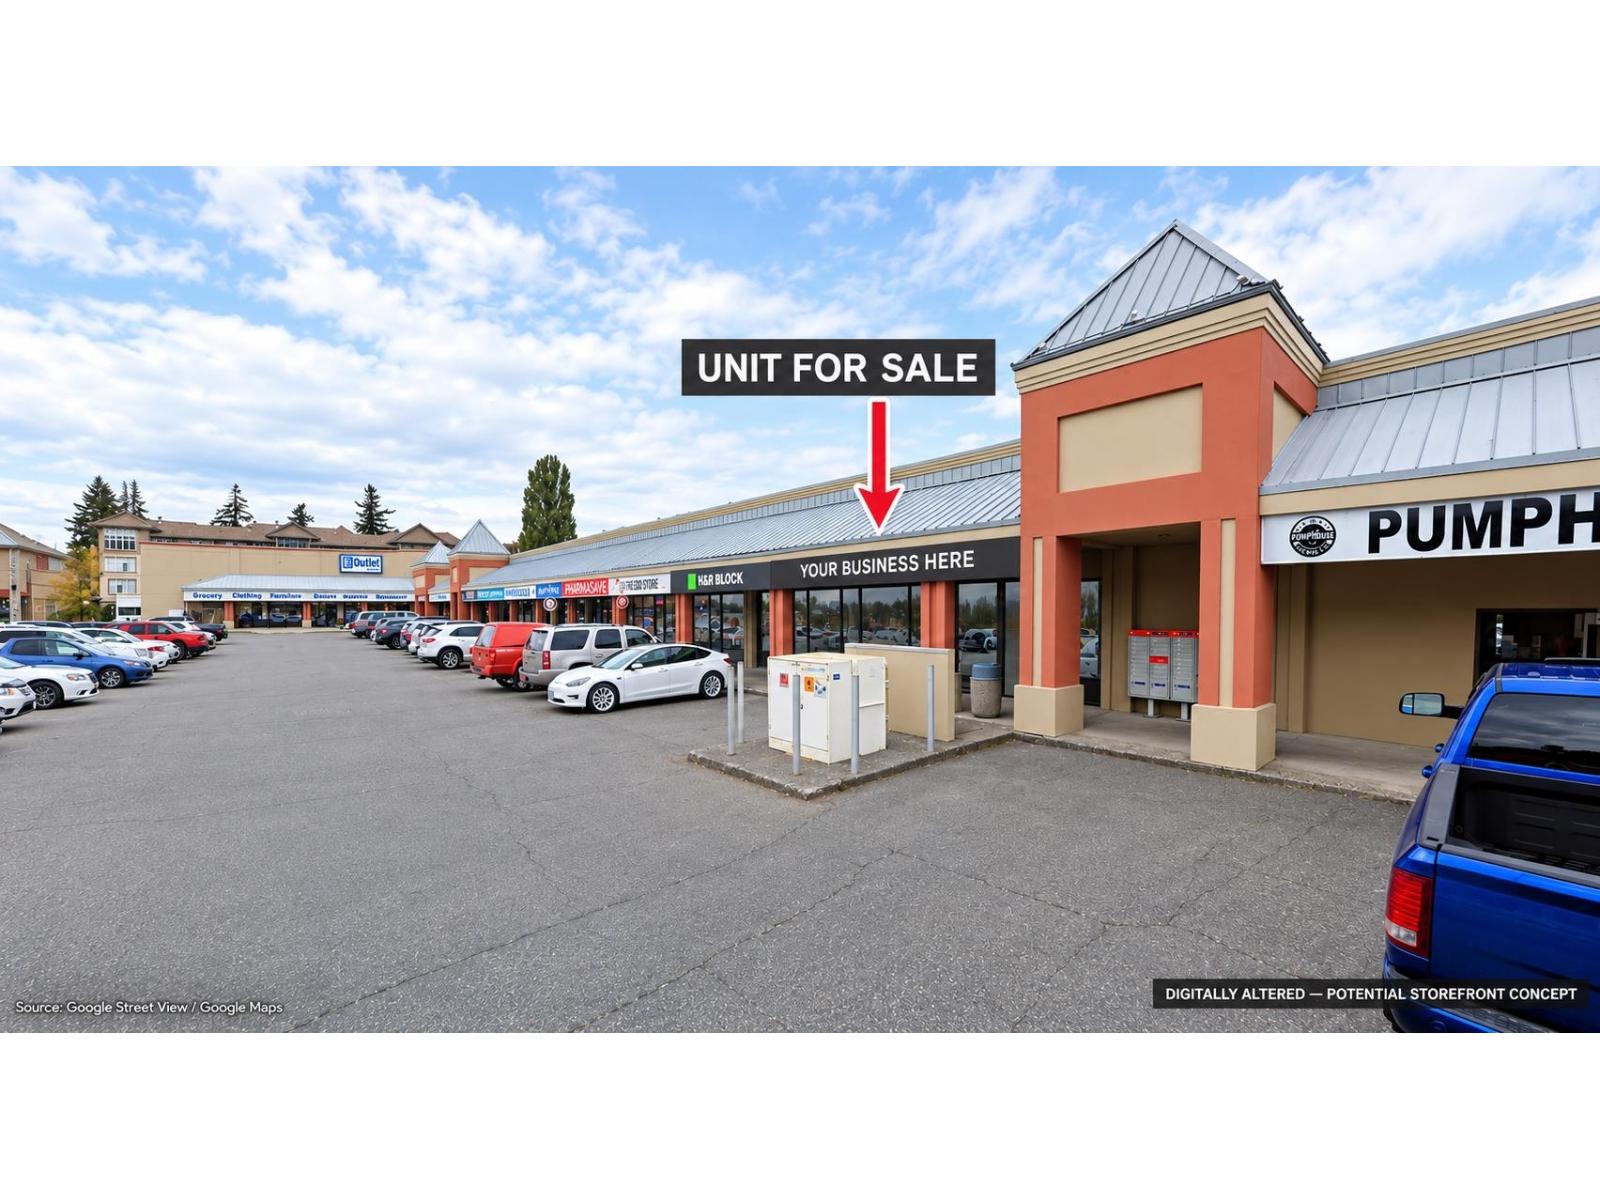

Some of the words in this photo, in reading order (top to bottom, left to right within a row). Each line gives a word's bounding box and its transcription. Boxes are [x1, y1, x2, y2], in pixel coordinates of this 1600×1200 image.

[1368, 491, 1600, 554] PUMPH
[353, 557, 380, 568] Outlet
[800, 561, 838, 579] YOUR
[842, 554, 919, 575] BUSINESS
[924, 549, 975, 570] HERE
[698, 574, 714, 587] H&R
[714, 571, 744, 586] BLOCK
[192, 592, 223, 600] Grocery
[232, 592, 262, 600] Clothing
[564, 580, 608, 596] PHARMASAVE
